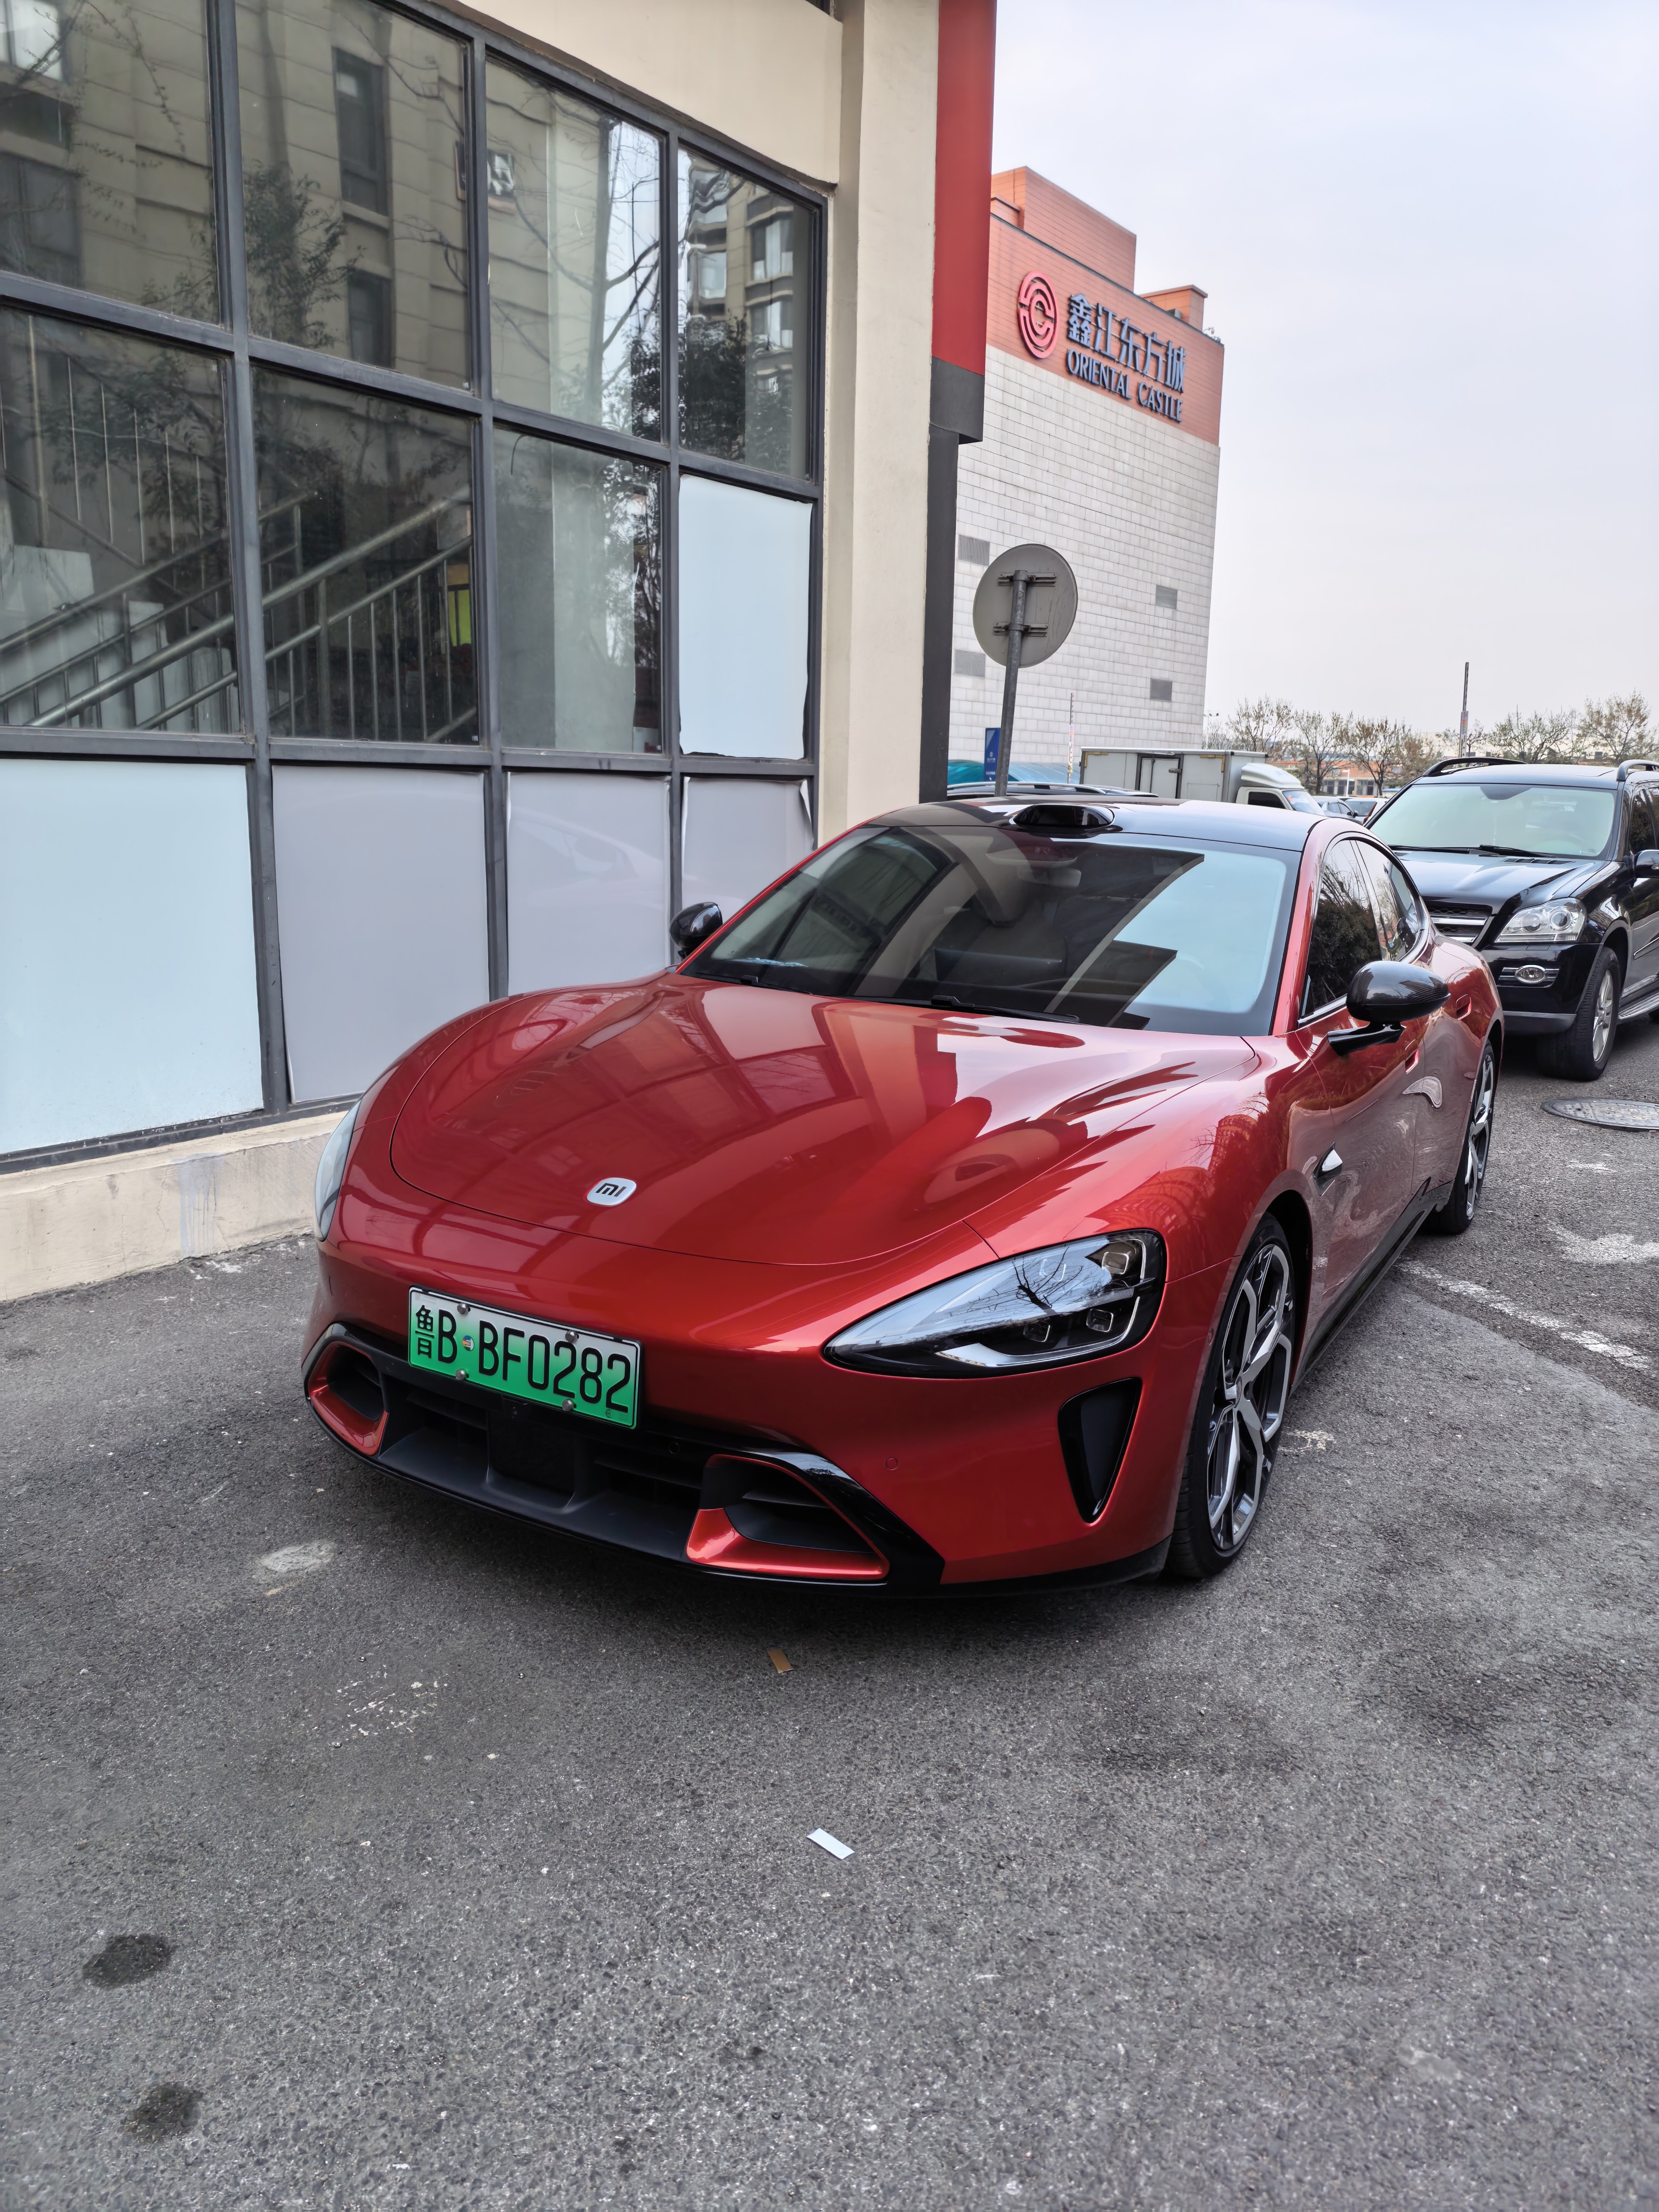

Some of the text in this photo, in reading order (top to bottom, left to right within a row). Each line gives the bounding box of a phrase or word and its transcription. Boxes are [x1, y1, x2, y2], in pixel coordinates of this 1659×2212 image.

[1066, 349, 1184, 423] ORIENTAL CASTLE
[1067, 294, 1186, 393] 鑫江东方城
